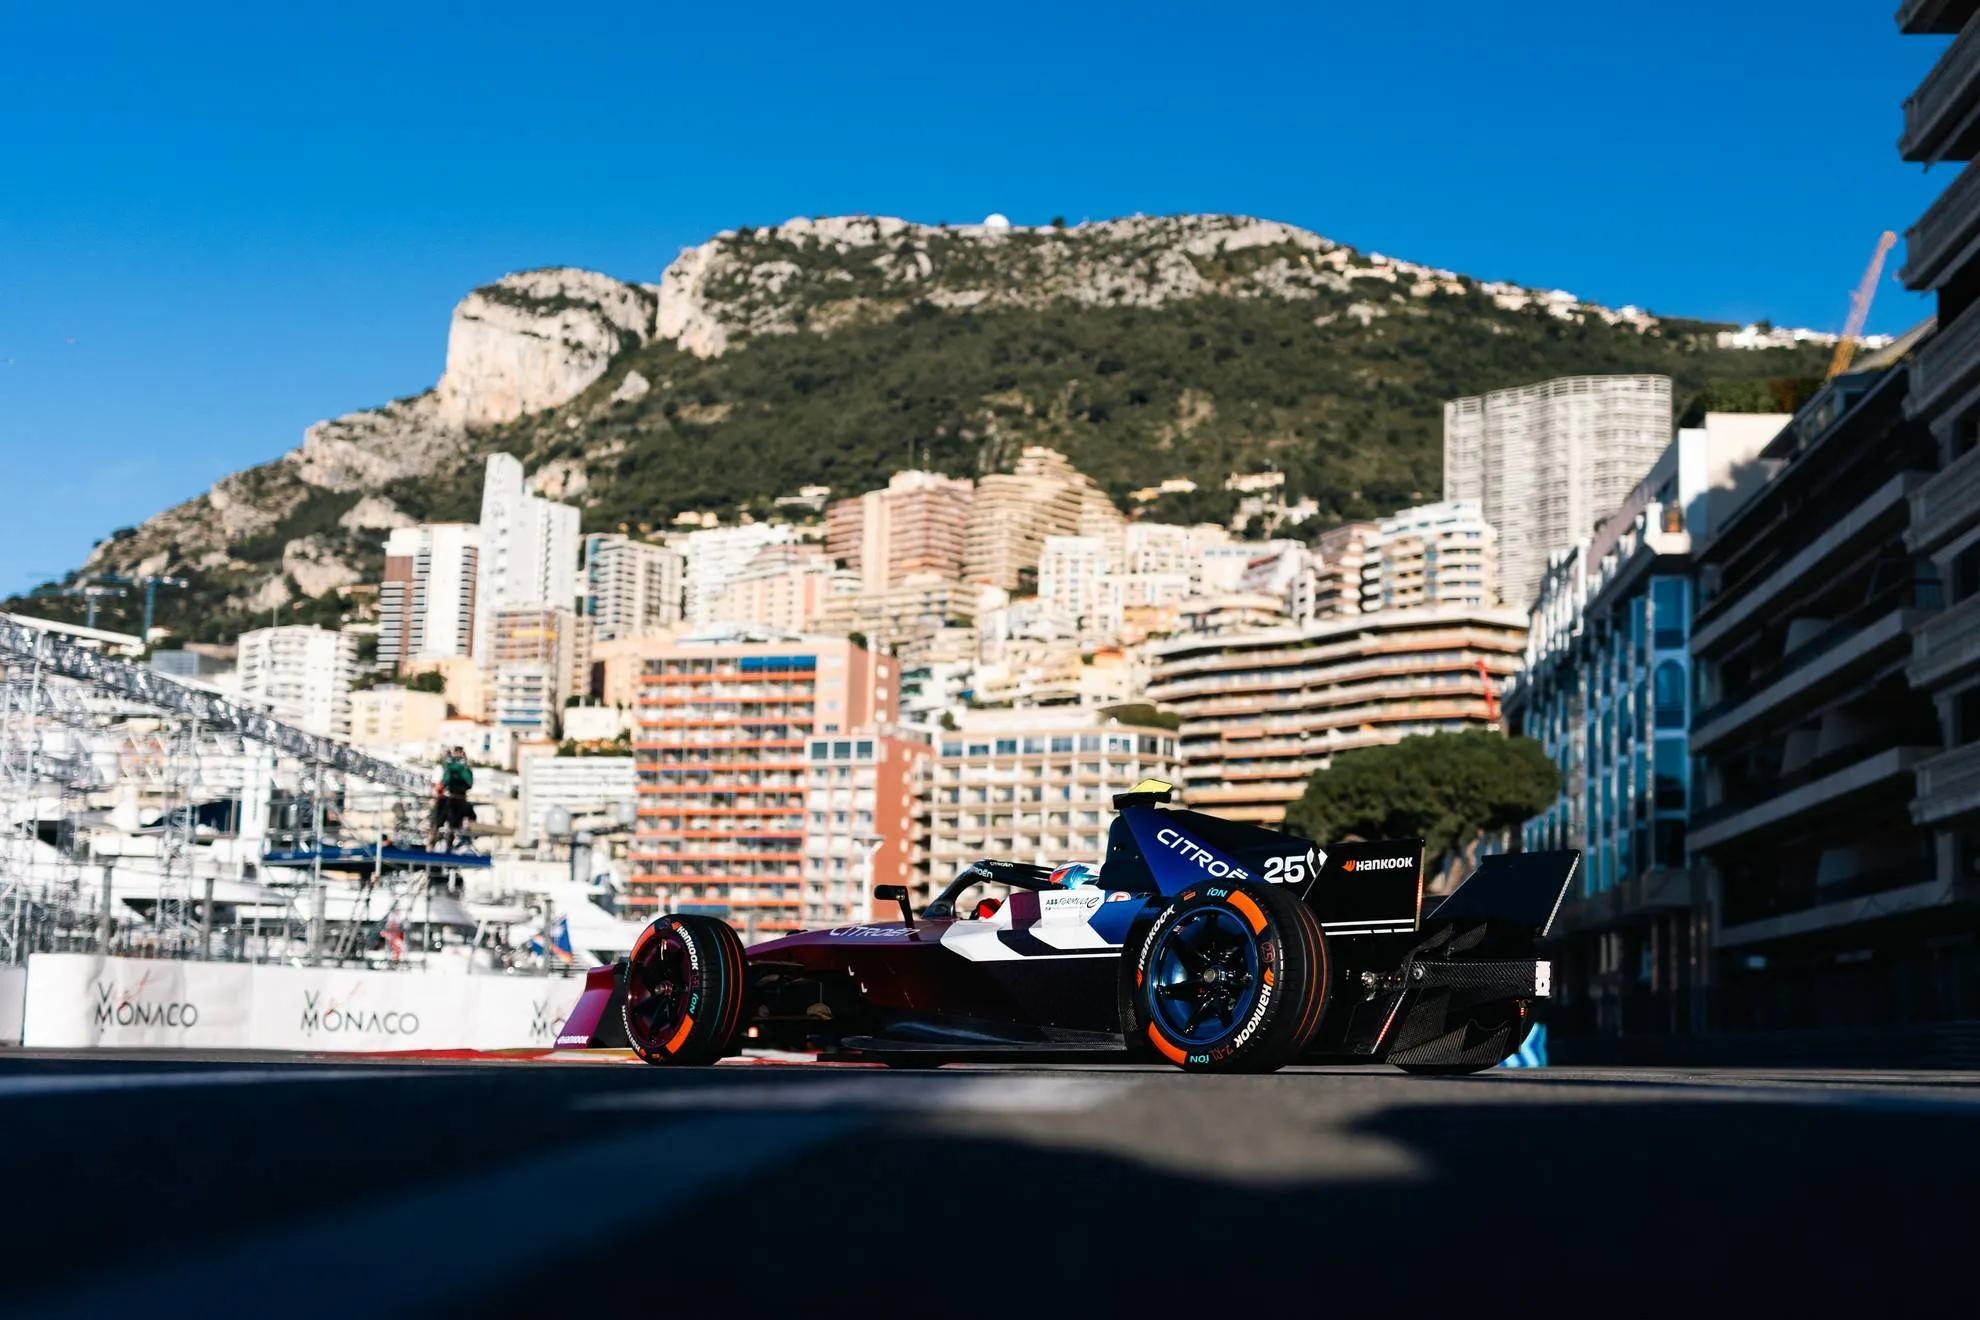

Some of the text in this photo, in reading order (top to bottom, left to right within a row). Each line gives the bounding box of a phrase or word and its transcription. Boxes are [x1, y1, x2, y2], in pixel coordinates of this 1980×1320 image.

[1157, 828, 1249, 880] CITROË
[1263, 855, 1306, 884] 25
[94, 1001, 199, 1028] MONACO
[300, 1007, 420, 1035] MONACO
